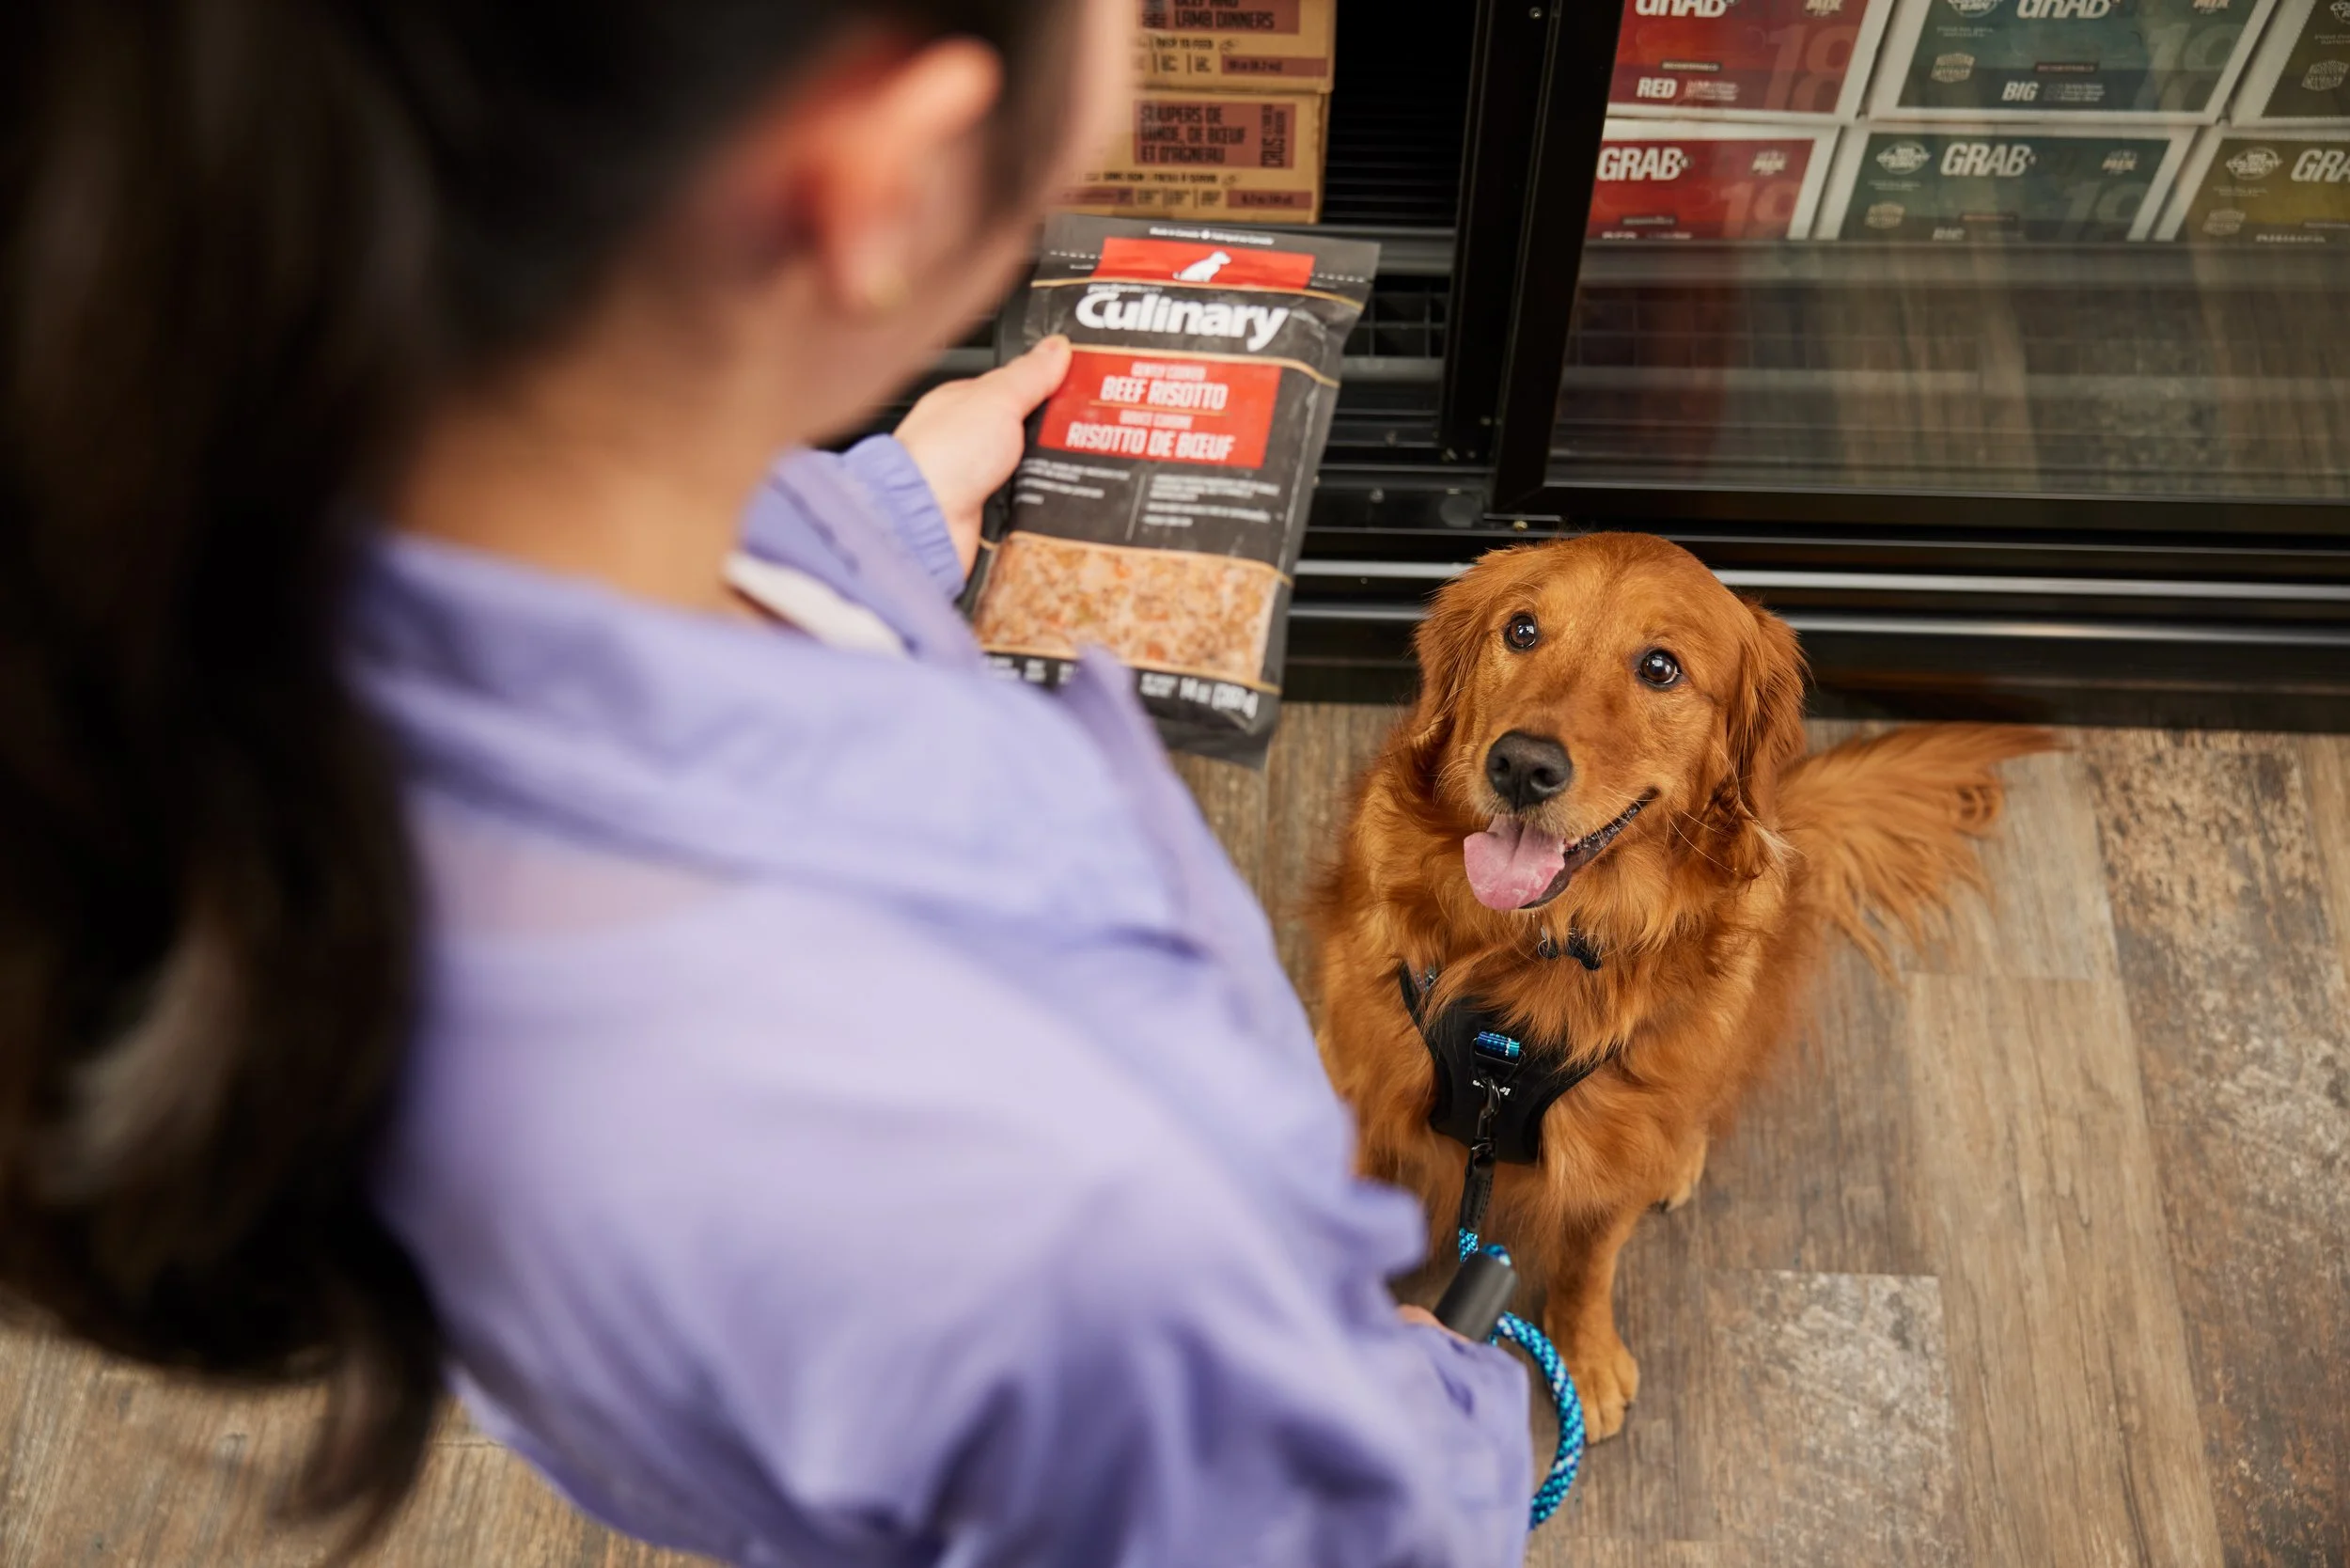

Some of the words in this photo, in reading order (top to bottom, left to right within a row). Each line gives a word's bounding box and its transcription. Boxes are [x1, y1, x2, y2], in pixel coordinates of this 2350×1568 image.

[1175, 10, 1213, 28] LAMB
[1216, 11, 1275, 29] DINNERS
[1636, 77, 1677, 99] RED
[2001, 81, 2039, 102] BIG
[1206, 107, 1222, 123] DE
[1140, 147, 1155, 163] ET
[1596, 147, 1684, 180] GRAB
[1940, 142, 2032, 177] GRAB
[1075, 290, 1290, 352] Culinary
[1100, 375, 1148, 402] BEEF
[1148, 379, 1229, 410] RISOTTO
[1065, 421, 1147, 454] RISOTTO
[1147, 430, 1176, 457] DE
[1175, 431, 1235, 461] BŒUF
